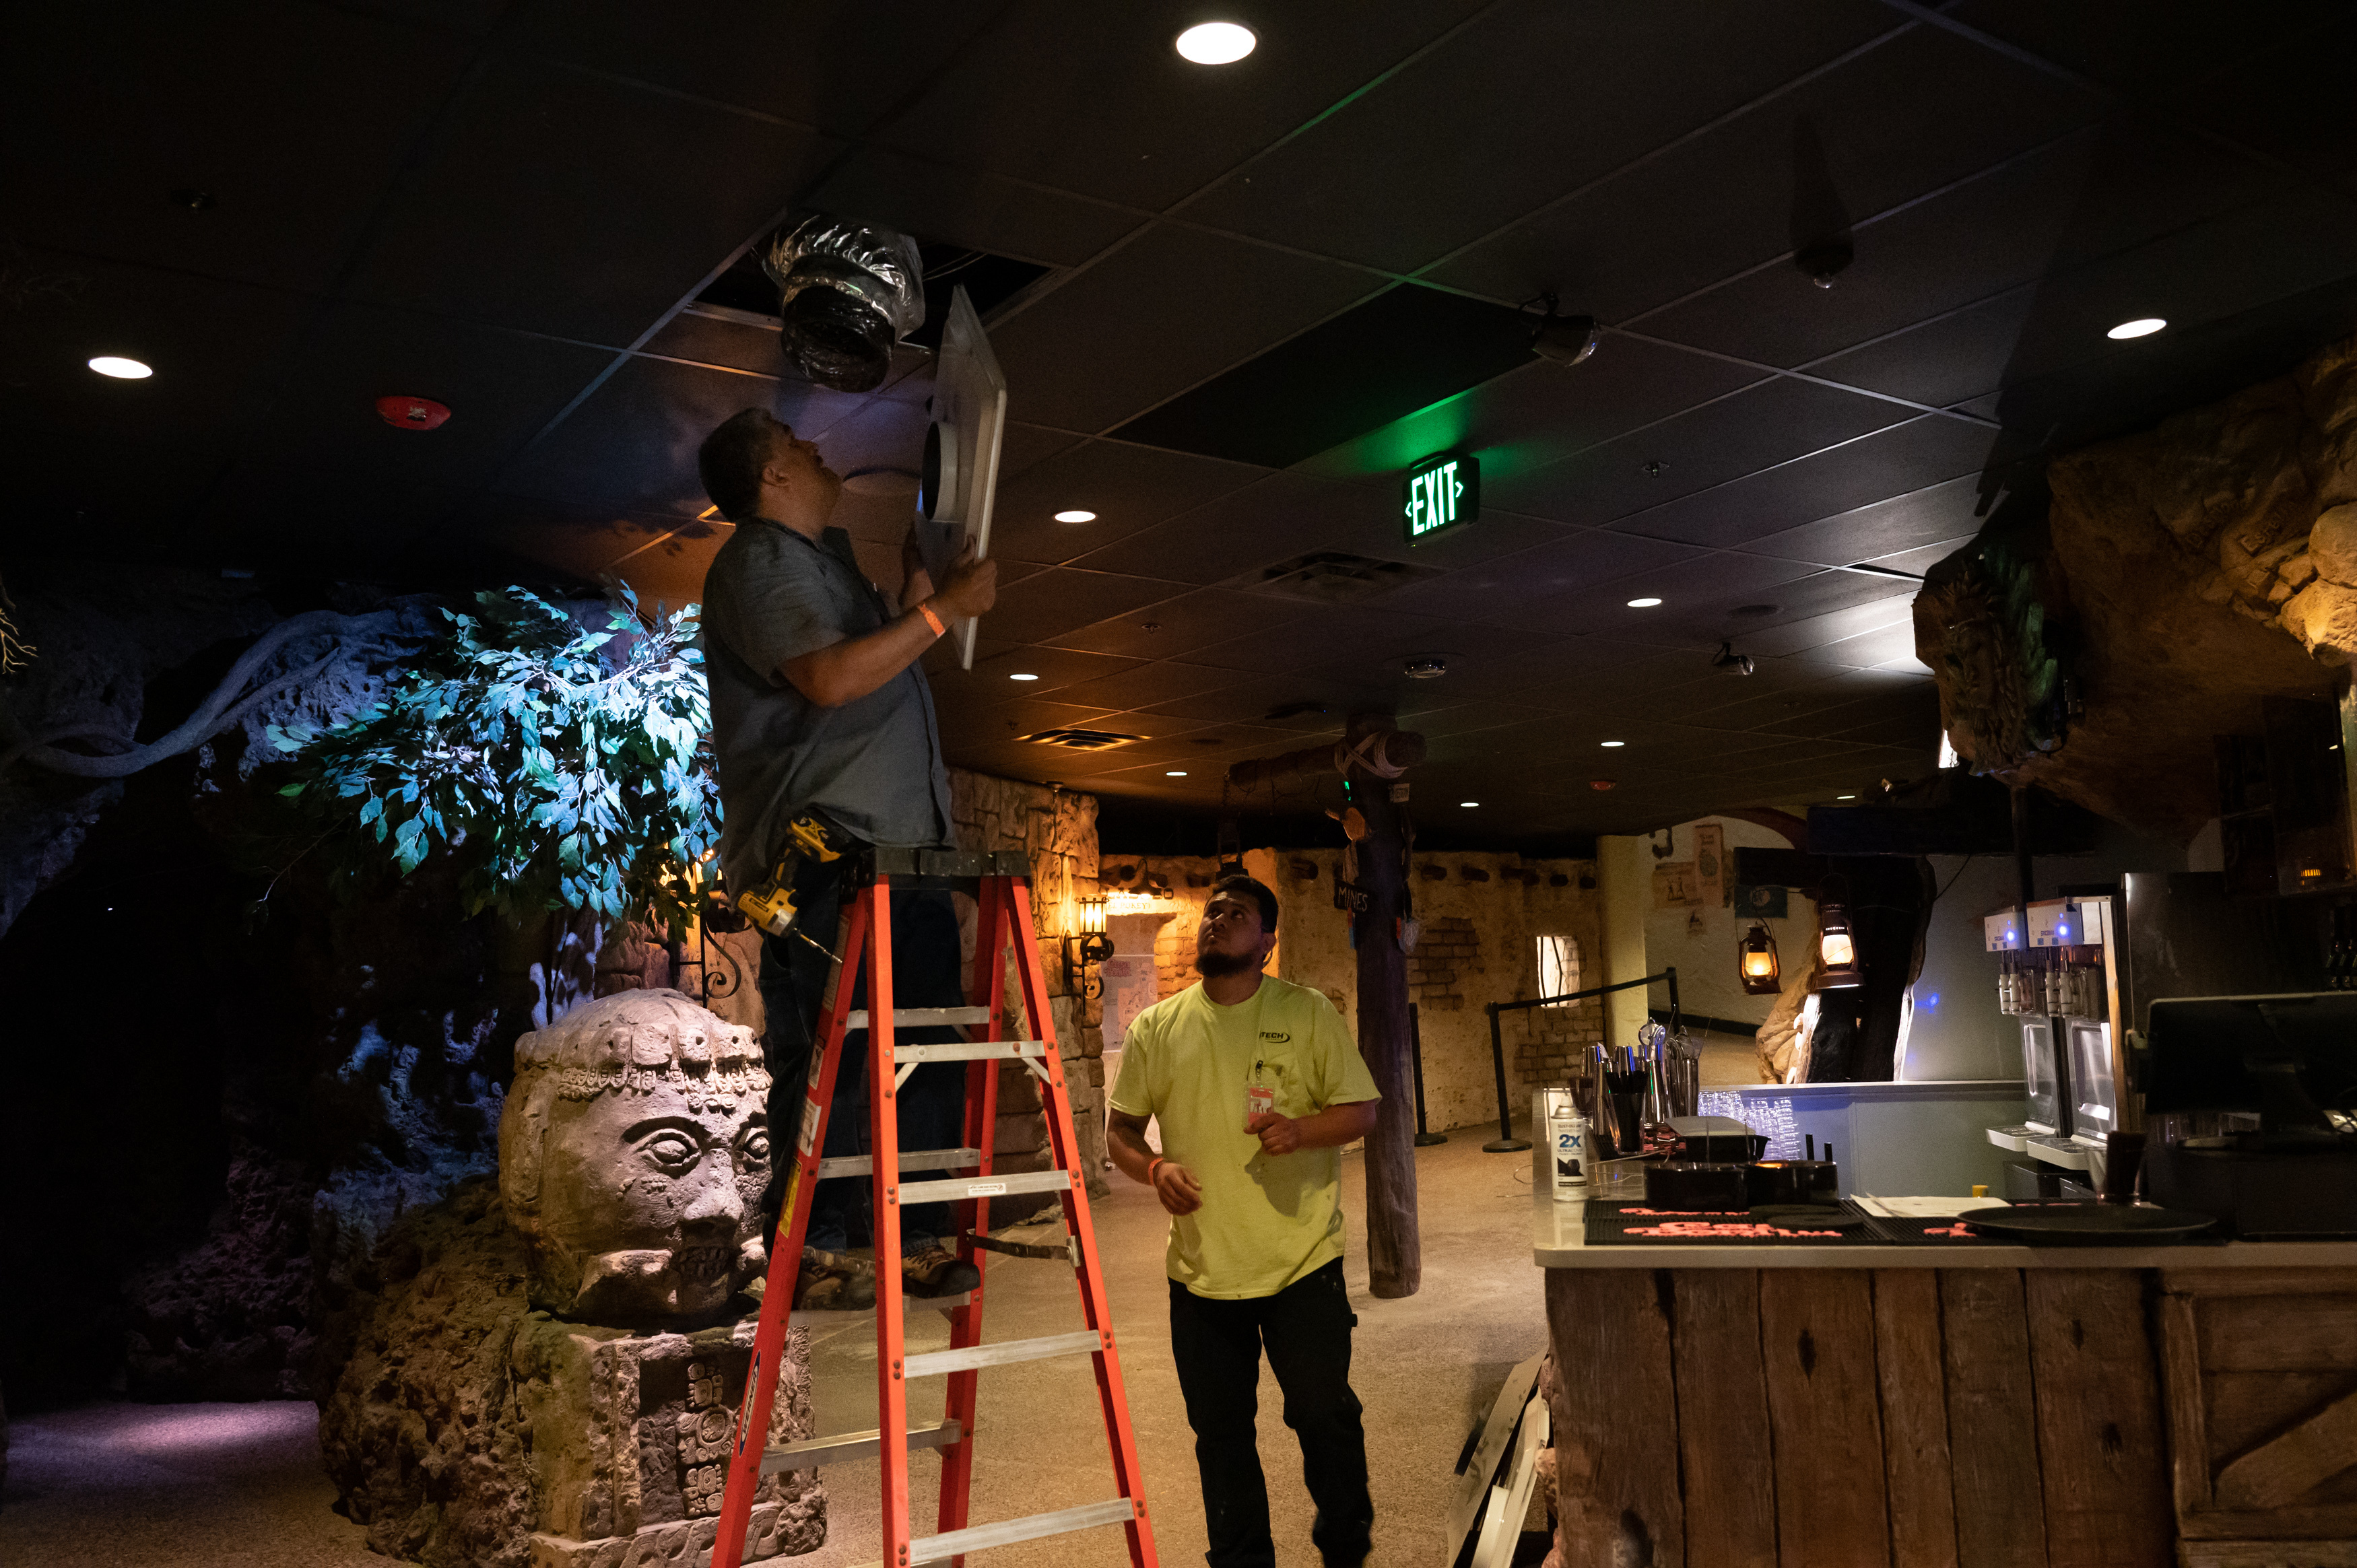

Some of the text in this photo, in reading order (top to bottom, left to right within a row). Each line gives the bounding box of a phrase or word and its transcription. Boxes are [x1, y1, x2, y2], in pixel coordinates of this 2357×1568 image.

[1412, 461, 1457, 535] EXIT
[1337, 886, 1368, 912] MINES
[1559, 1134, 1581, 1147] 2X
[743, 1370, 757, 1434] WERNER
